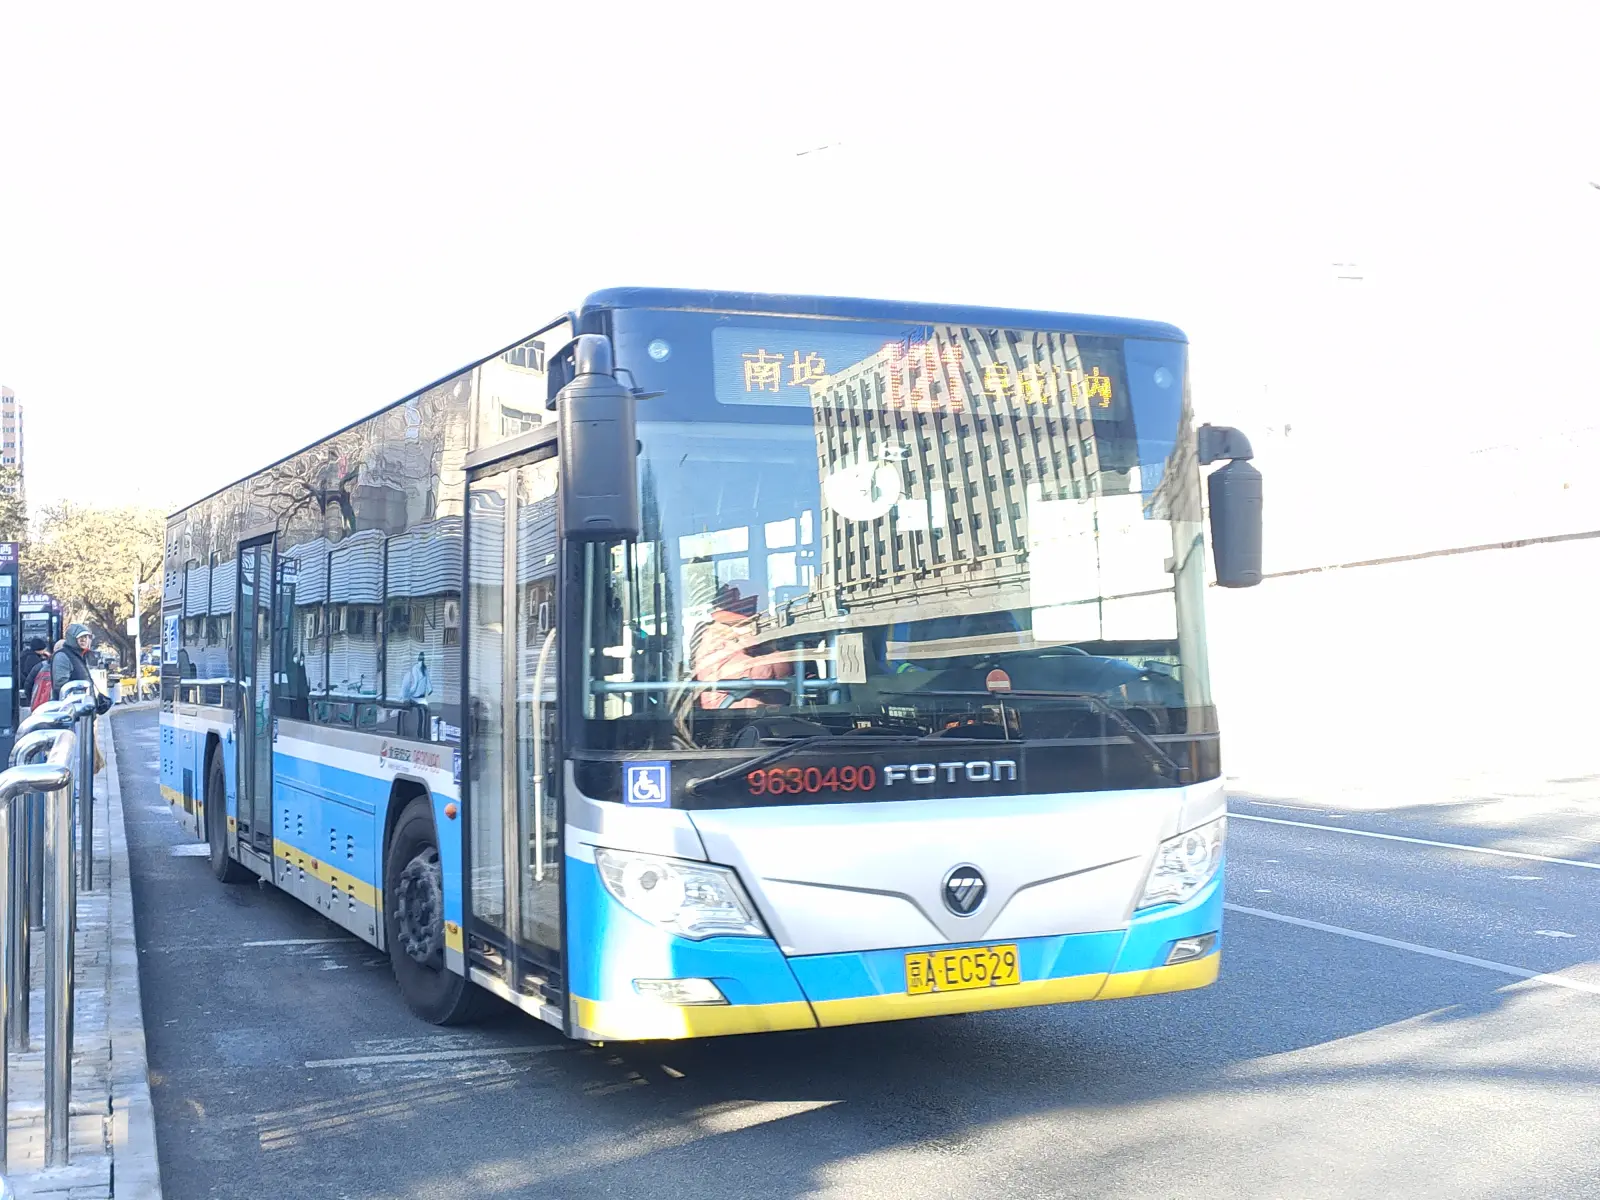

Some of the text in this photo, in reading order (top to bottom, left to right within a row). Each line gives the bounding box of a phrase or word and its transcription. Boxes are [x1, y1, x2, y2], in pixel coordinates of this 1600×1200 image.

[881, 342, 964, 413] 121
[747, 765, 877, 795] 9630490
[883, 759, 1018, 787] FOTON
